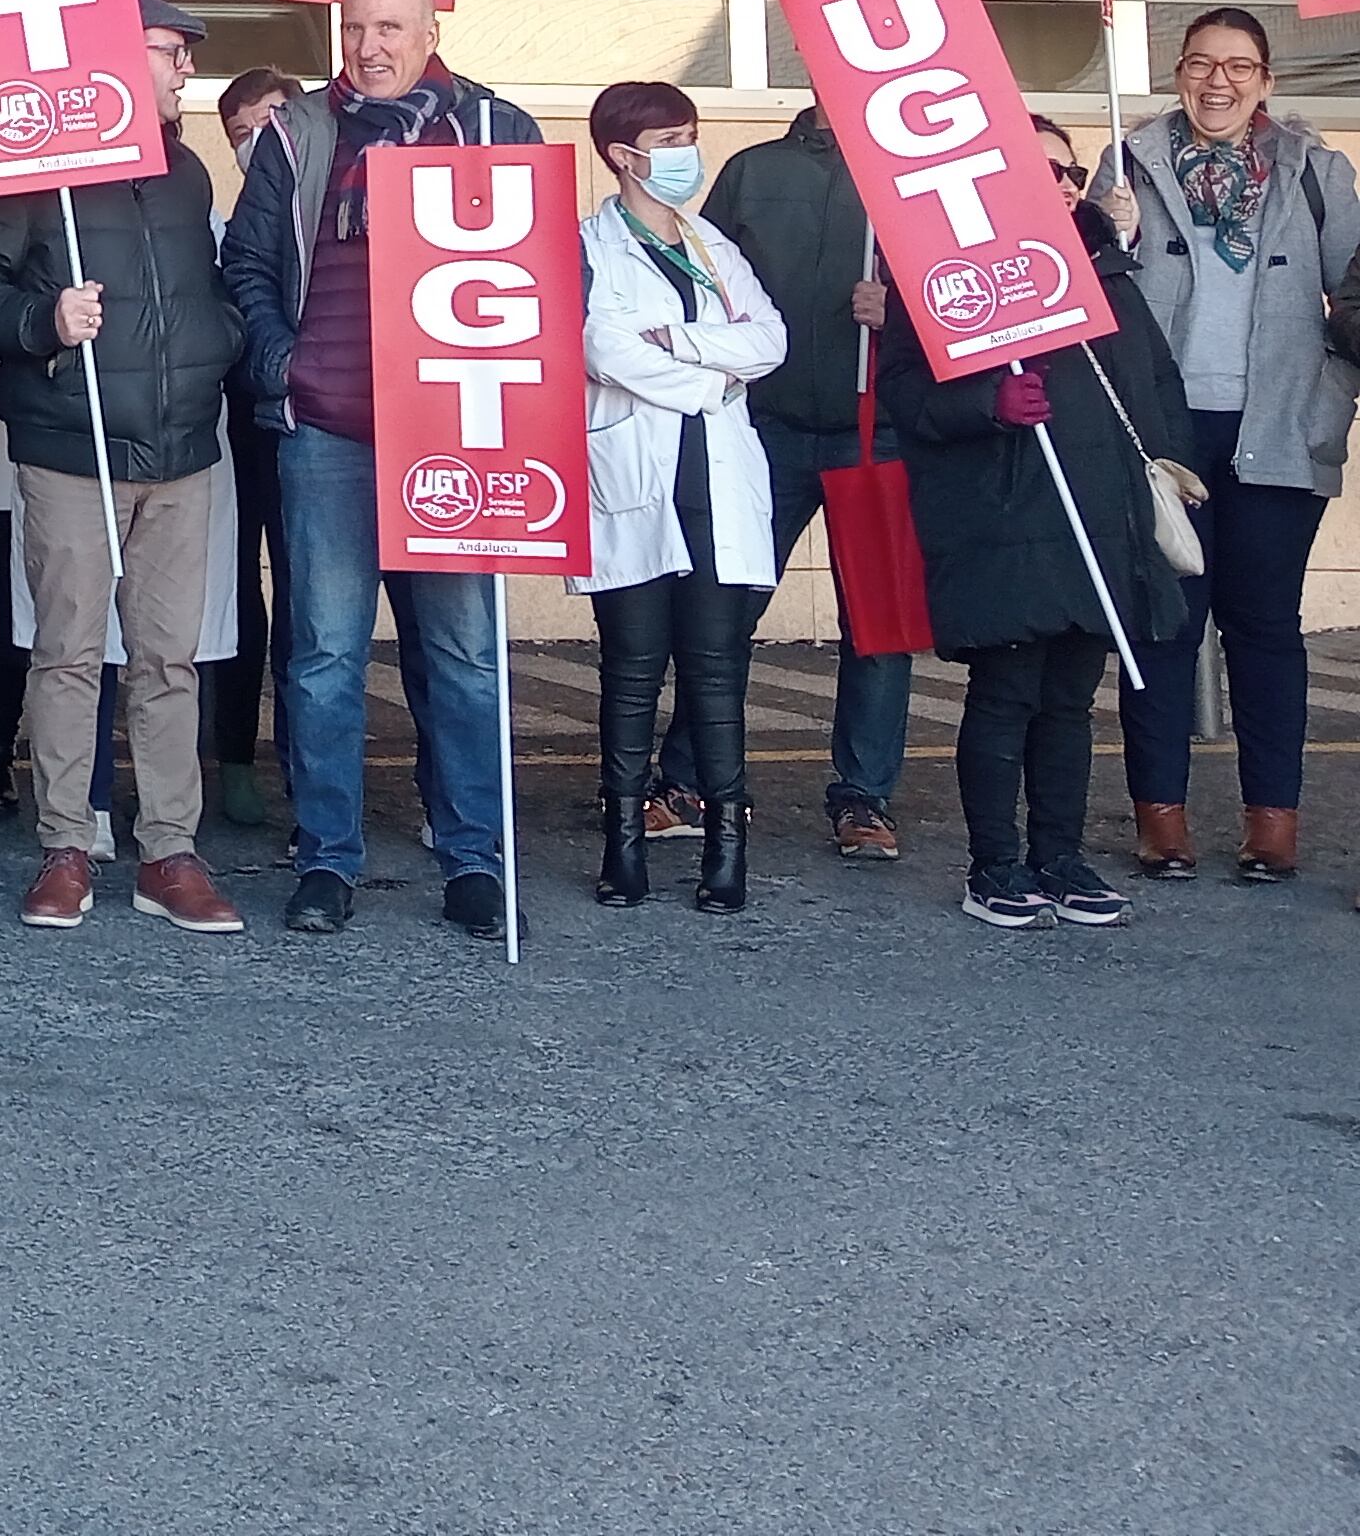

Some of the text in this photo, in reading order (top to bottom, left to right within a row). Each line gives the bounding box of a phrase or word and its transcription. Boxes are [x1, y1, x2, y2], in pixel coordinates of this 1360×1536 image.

[57, 87, 97, 111] FSP
[991, 256, 1030, 283] FSP
[931, 269, 980, 302] UGT
[411, 164, 543, 450] UGT
[415, 469, 468, 496] UGT
[487, 473, 529, 494] FSP
